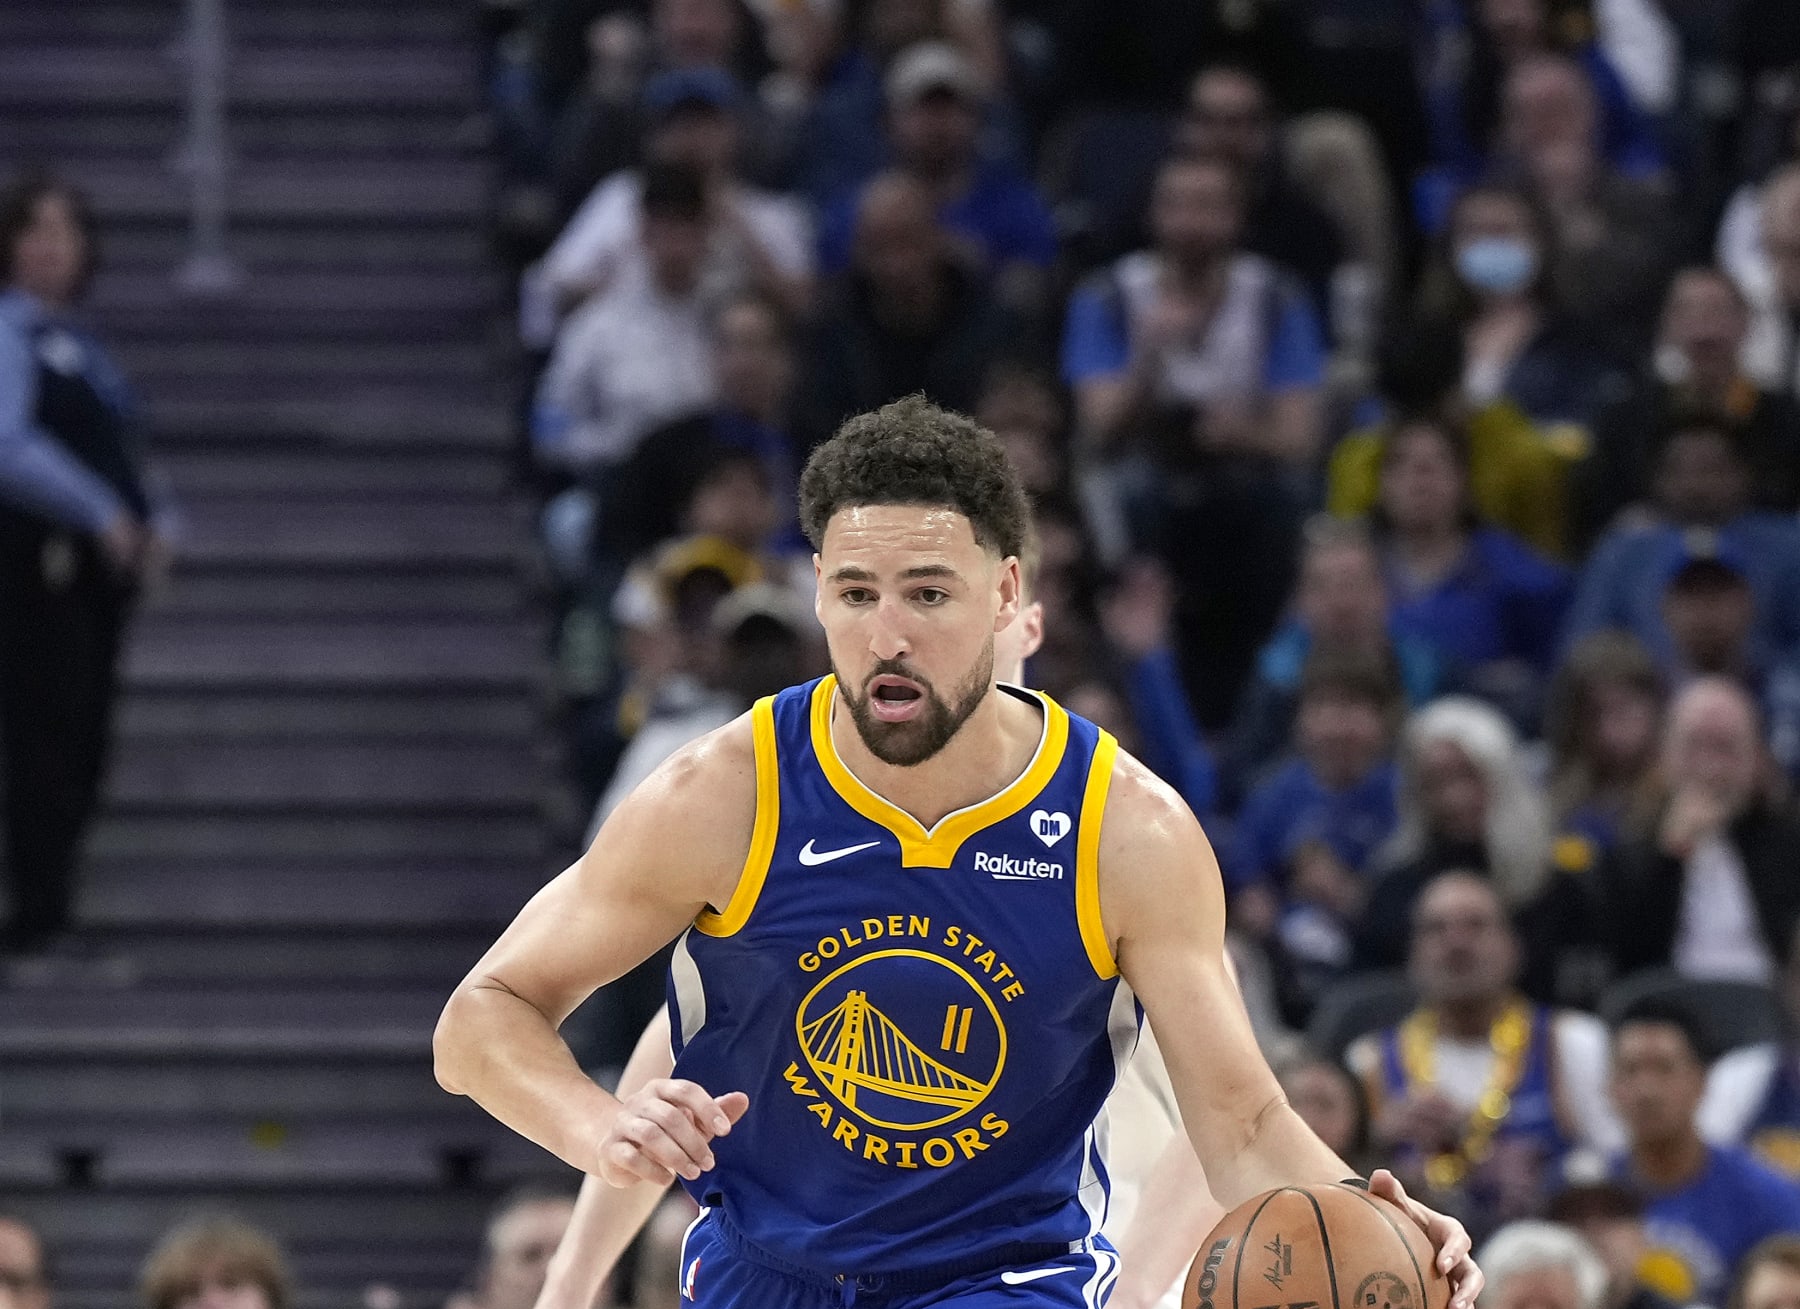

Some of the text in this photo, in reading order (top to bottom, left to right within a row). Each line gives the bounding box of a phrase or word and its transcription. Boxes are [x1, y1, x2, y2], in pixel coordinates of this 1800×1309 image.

[1040, 819, 1060, 836] DM
[974, 851, 1063, 880] Rakuten
[798, 915, 1025, 1002] GOLDEN STATE
[940, 1004, 973, 1053] 11
[783, 1061, 1009, 1169] WARRIORS
